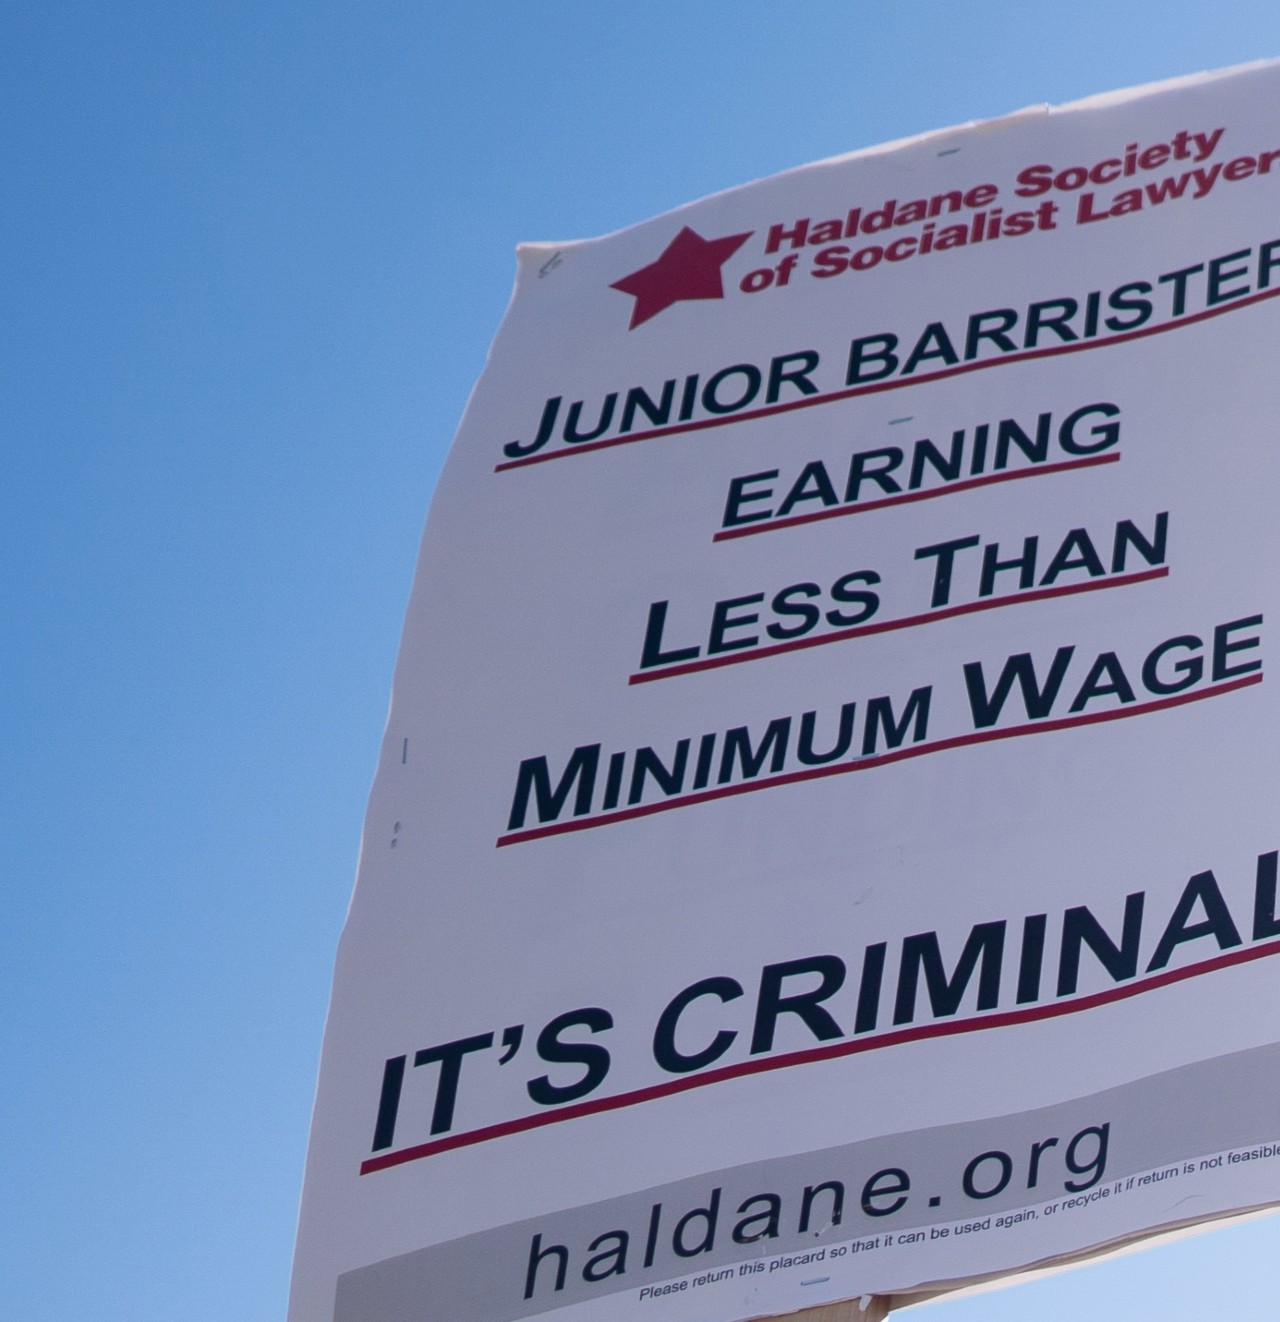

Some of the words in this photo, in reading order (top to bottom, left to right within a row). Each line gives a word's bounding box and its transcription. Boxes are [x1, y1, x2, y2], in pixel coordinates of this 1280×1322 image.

[739, 257, 798, 294] of
[810, 200, 1058, 278] Socialist
[764, 183, 1000, 254] Haldane
[1014, 127, 1225, 198] Society
[502, 349, 821, 462] JUNIOR
[722, 400, 1123, 528] EARNING
[639, 569, 882, 669] LESS
[913, 510, 1169, 609] THAN
[505, 685, 934, 832] MINIMUM
[963, 613, 1265, 729] WAGE
[372, 1005, 612, 1153] IT’S
[524, 1120, 1110, 1300] haldane.org
[639, 1279, 688, 1301] Please
[692, 1269, 734, 1287] return
[739, 1258, 765, 1276] this
[769, 1250, 826, 1273] placard
[830, 1245, 848, 1258] so
[851, 1237, 880, 1254] that
[883, 1234, 894, 1247] it
[897, 1232, 926, 1246] can
[930, 1225, 950, 1239] be
[954, 1219, 991, 1236] used
[995, 1207, 1039, 1229] again,
[1044, 1202, 1059, 1216] or
[1061, 1186, 1110, 1211] recycle
[1114, 1181, 1123, 1194] it
[1126, 1176, 1136, 1190] if
[1138, 1167, 1179, 1187] return
[1183, 1162, 1195, 1174] is
[1200, 1156, 1224, 1171] not
